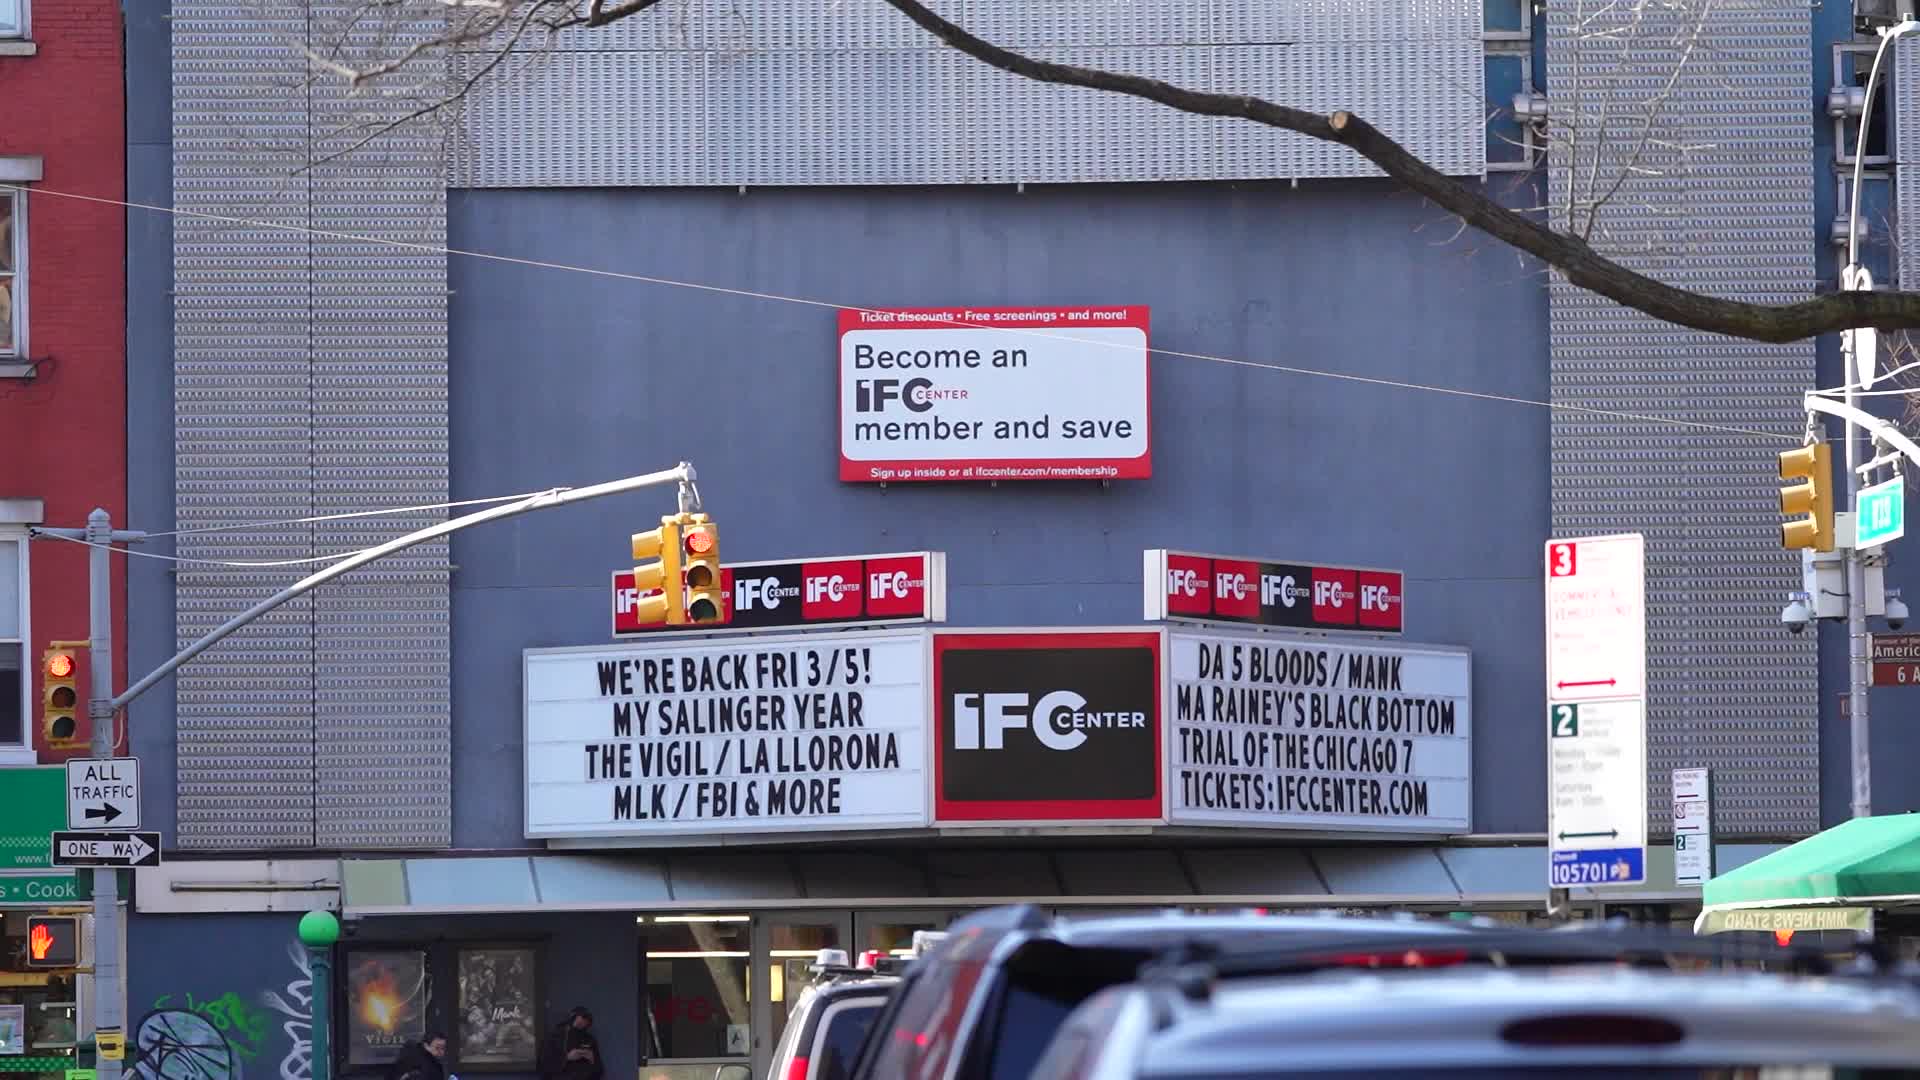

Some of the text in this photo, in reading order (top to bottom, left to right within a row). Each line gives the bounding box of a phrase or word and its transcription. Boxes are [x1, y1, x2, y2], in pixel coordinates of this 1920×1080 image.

[859, 309, 1127, 322] Ticket discounts Free screenings and more!
[854, 344, 1028, 369] Become an
[916, 389, 969, 400] CENTER
[854, 414, 1132, 441] member and save
[871, 465, 1118, 479] Sign up inside or at ifccenter.com/membership
[1554, 545, 1572, 576] 3
[769, 587, 800, 598] CENTER
[1198, 643, 1224, 681] DA
[1231, 645, 1243, 682] 5
[597, 657, 674, 696] WE'RE
[681, 654, 748, 693] BACK
[756, 650, 798, 689] FRI
[1897, 666, 1906, 683] 6
[613, 691, 864, 737] MY SALINGER YEAR
[1177, 684, 1455, 735] MA RAINEY'S BLACK BOTTOM
[1056, 712, 1145, 729] CENTER
[1556, 705, 1573, 736] 2
[585, 743, 633, 779] THE
[777, 732, 900, 772] LLORONA
[1179, 728, 1413, 774] TRIAL OF THE CHICAGO 7
[85, 765, 122, 781] ALL
[73, 784, 134, 800] TRAFFIC
[745, 780, 760, 816] &
[768, 777, 842, 815] MORE
[68, 842, 144, 856] ONE WAY
[1676, 835, 1685, 851] 2
[1553, 863, 1607, 883] 105701
[26, 881, 77, 897] Cook
